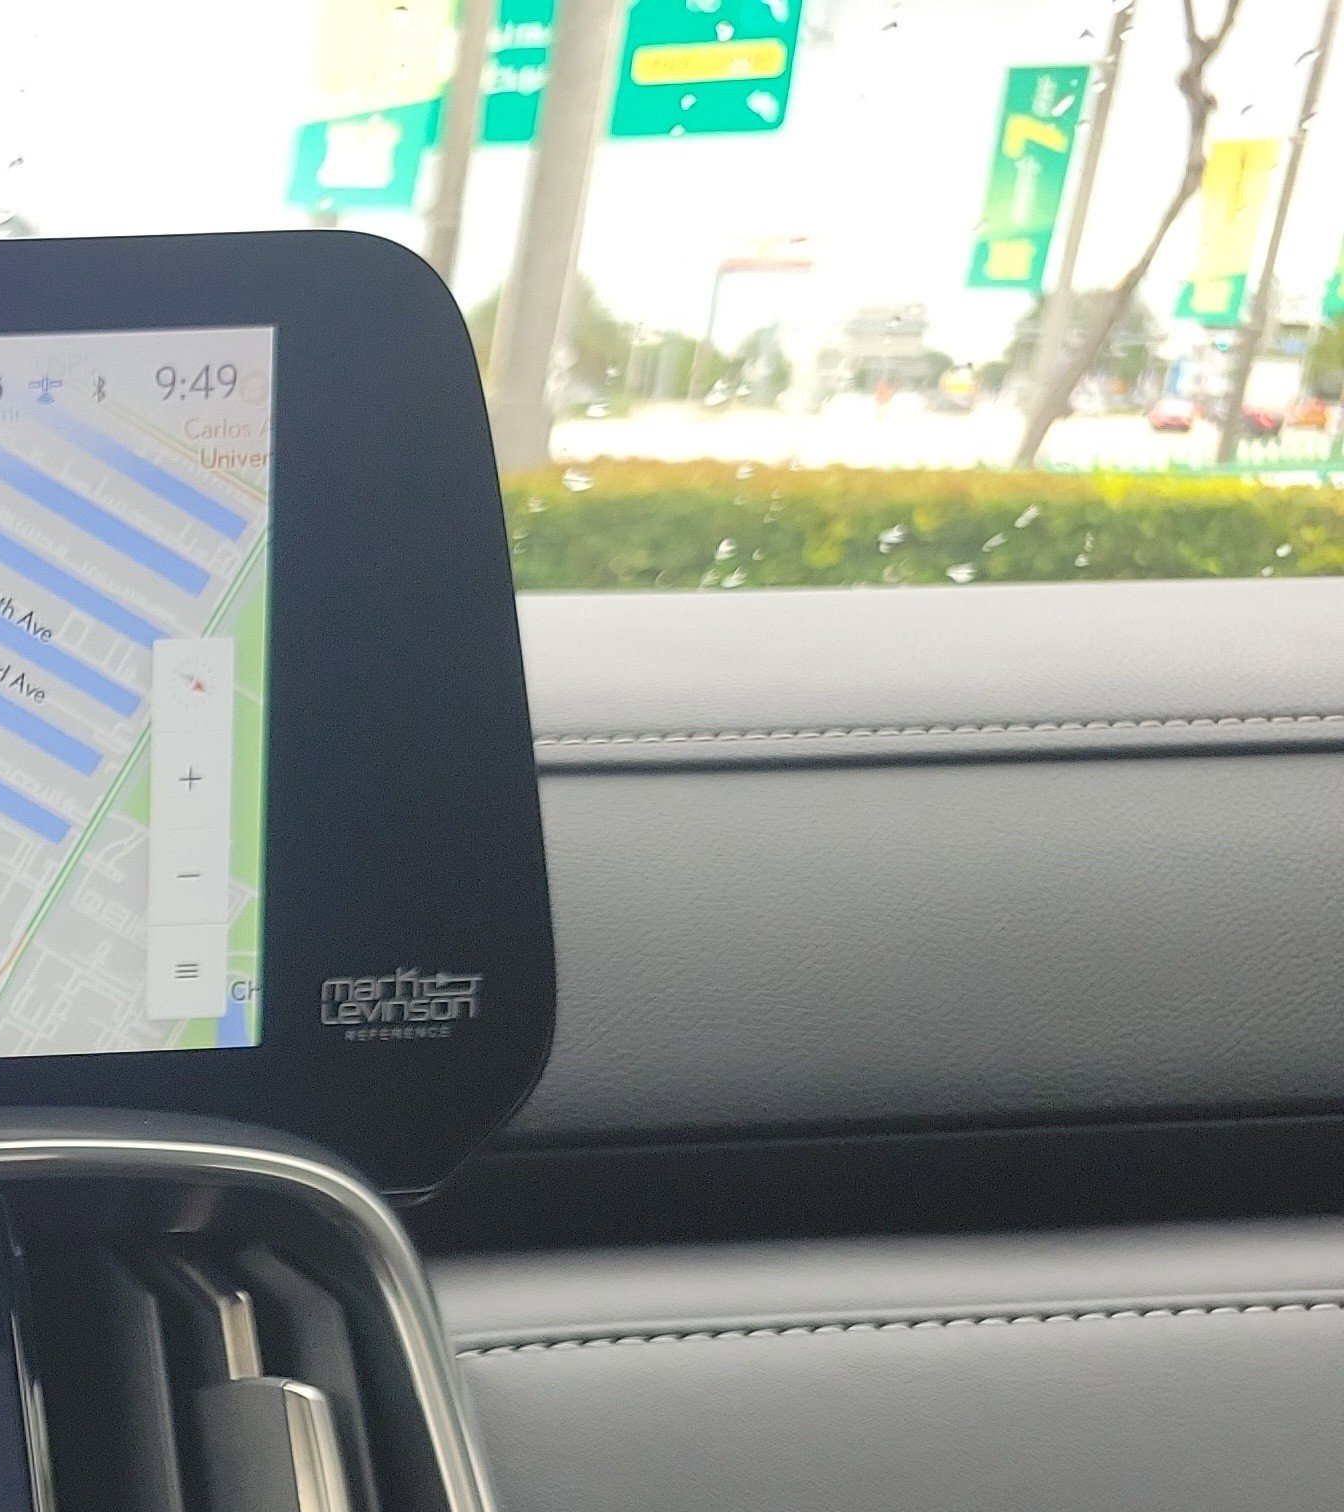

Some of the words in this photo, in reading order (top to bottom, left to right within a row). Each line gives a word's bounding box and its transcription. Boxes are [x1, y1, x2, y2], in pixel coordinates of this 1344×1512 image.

[155, 363, 238, 401] 9:49
[184, 416, 252, 440] Carlos
[200, 448, 267, 469] Univer
[17, 611, 52, 643] Ave
[9, 673, 46, 704] Ave
[321, 997, 477, 1025] Levinson
